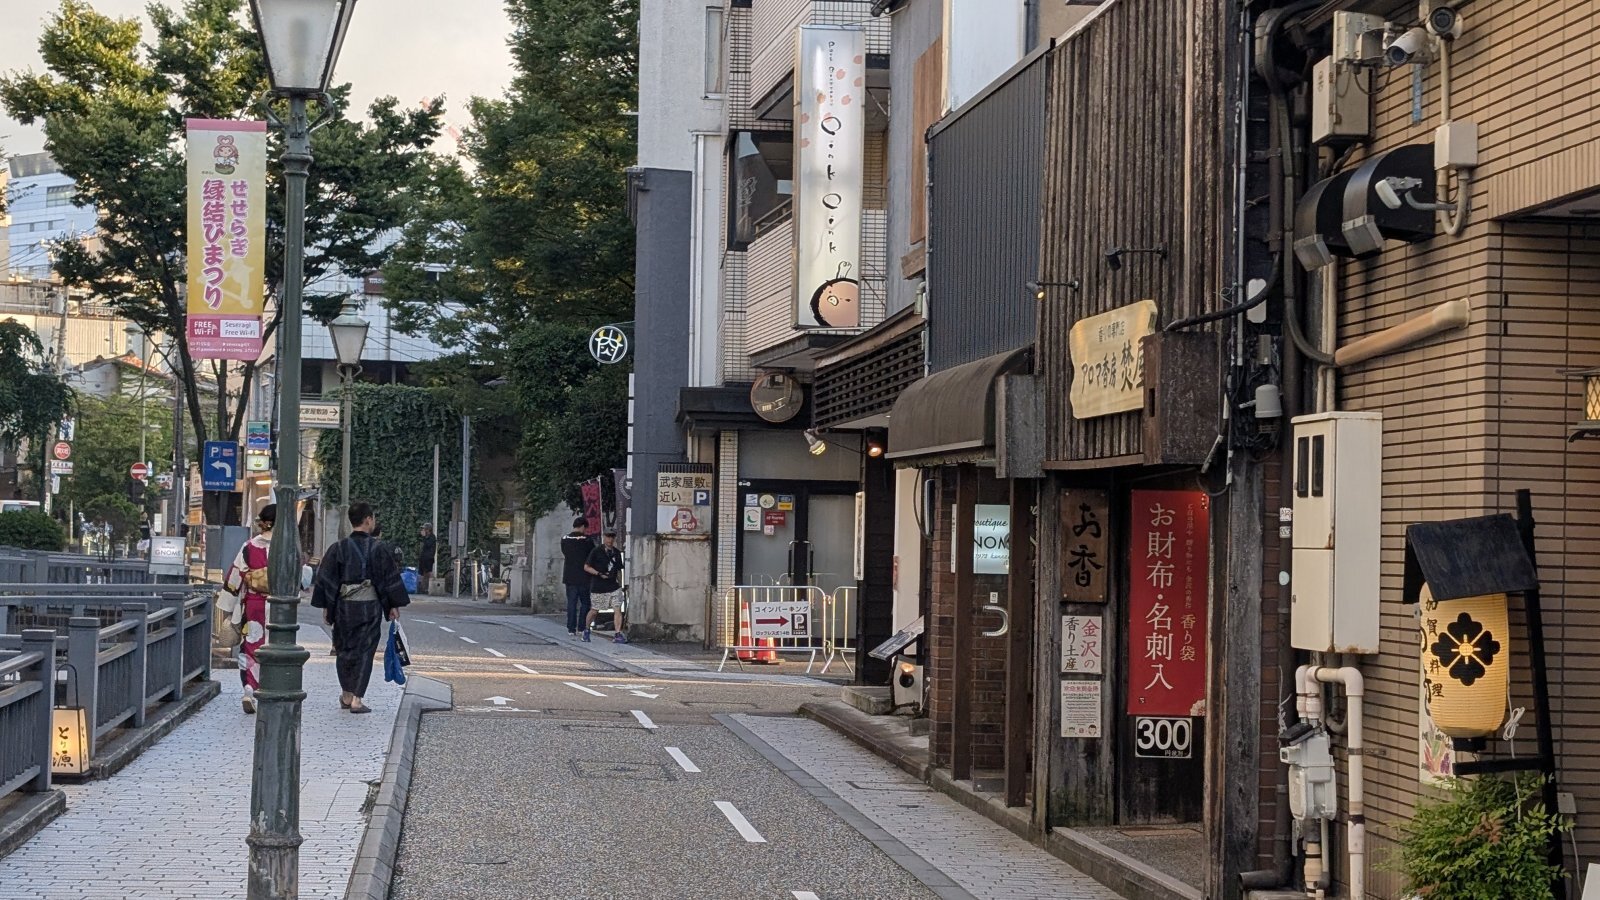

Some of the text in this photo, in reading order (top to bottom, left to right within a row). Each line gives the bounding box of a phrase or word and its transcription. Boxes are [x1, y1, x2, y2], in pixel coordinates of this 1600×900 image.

[230, 179, 249, 259] せせらぎ
[201, 178, 227, 310] 縁結びまつり
[194, 321, 212, 329] FREE
[225, 321, 252, 330] Seseragi
[194, 328, 214, 336] Wi-Fi
[225, 329, 256, 337] Free Wi-Fi
[211, 447, 219, 457] P
[659, 476, 711, 489] 武家屋敷に
[659, 491, 707, 504] 近い P
[974, 518, 1008, 531] outique
[1067, 503, 1105, 587] お香
[155, 548, 182, 557] GNOME
[1144, 502, 1176, 691] お財布・名刺入
[755, 605, 809, 613] コインパーキング
[1064, 616, 1080, 671] 香り土産
[1080, 618, 1101, 670] 金沢の
[1179, 614, 1196, 661] 香り袋
[1425, 597, 1445, 699] 加賀料理
[1137, 719, 1190, 750] 300
